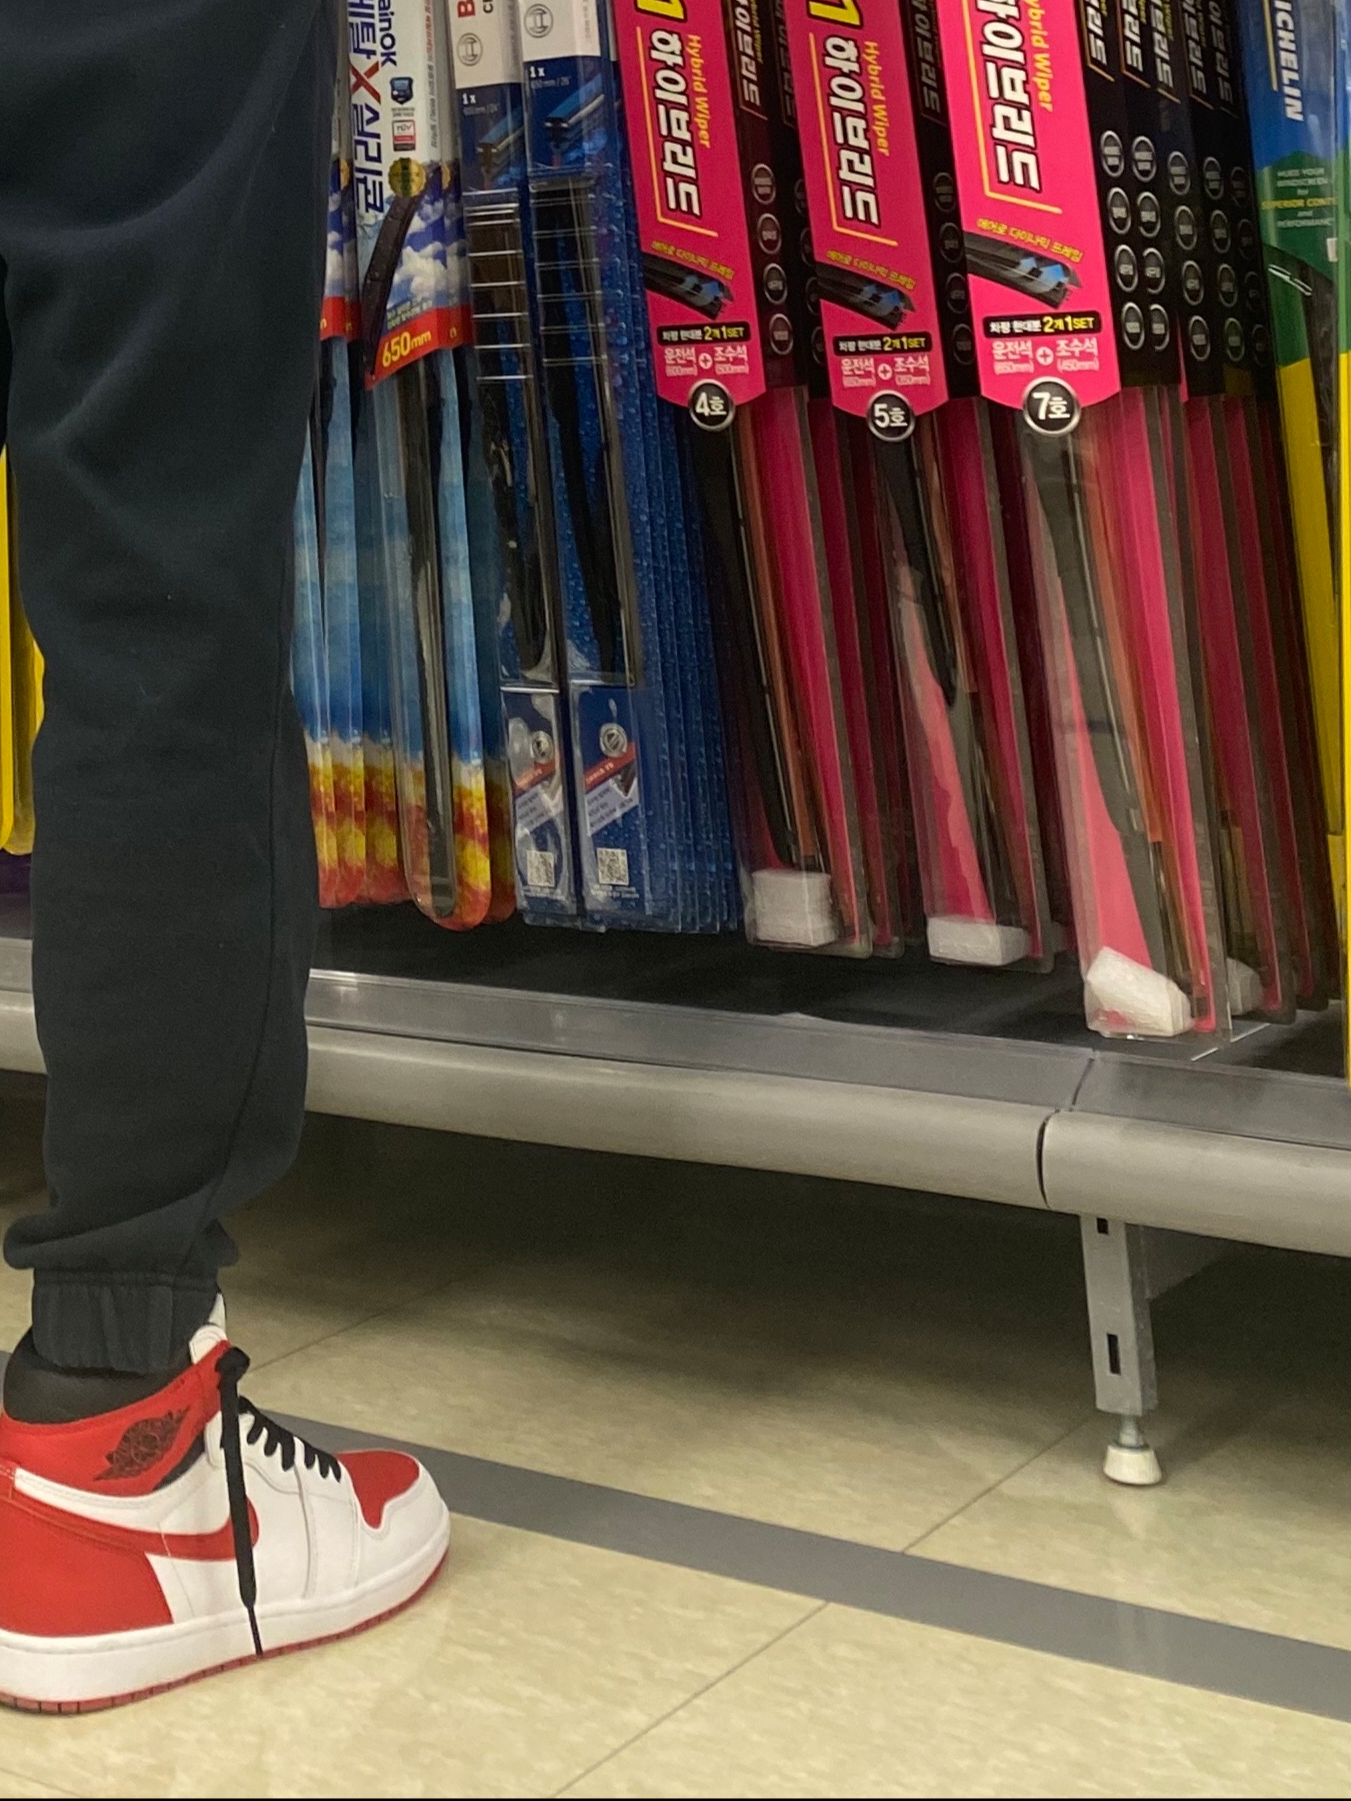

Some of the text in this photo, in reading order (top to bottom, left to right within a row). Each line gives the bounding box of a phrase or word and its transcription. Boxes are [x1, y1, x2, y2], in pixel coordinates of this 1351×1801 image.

[686, 33, 712, 149] Hybrid Wiper
[1033, 48, 1054, 113] Wiper
[862, 40, 890, 157] Hybrid Wiper
[649, 28, 702, 219] 하이브리드
[822, 34, 880, 227] 하이브리드
[1065, 315, 1095, 331] 1SET
[381, 328, 432, 368] 650mm
[840, 355, 930, 375] 운전석 조수석
[991, 337, 1098, 360] 운전석 조수석
[695, 391, 727, 417] 4호
[873, 403, 908, 428] 5호
[1032, 391, 1071, 421] 7호
